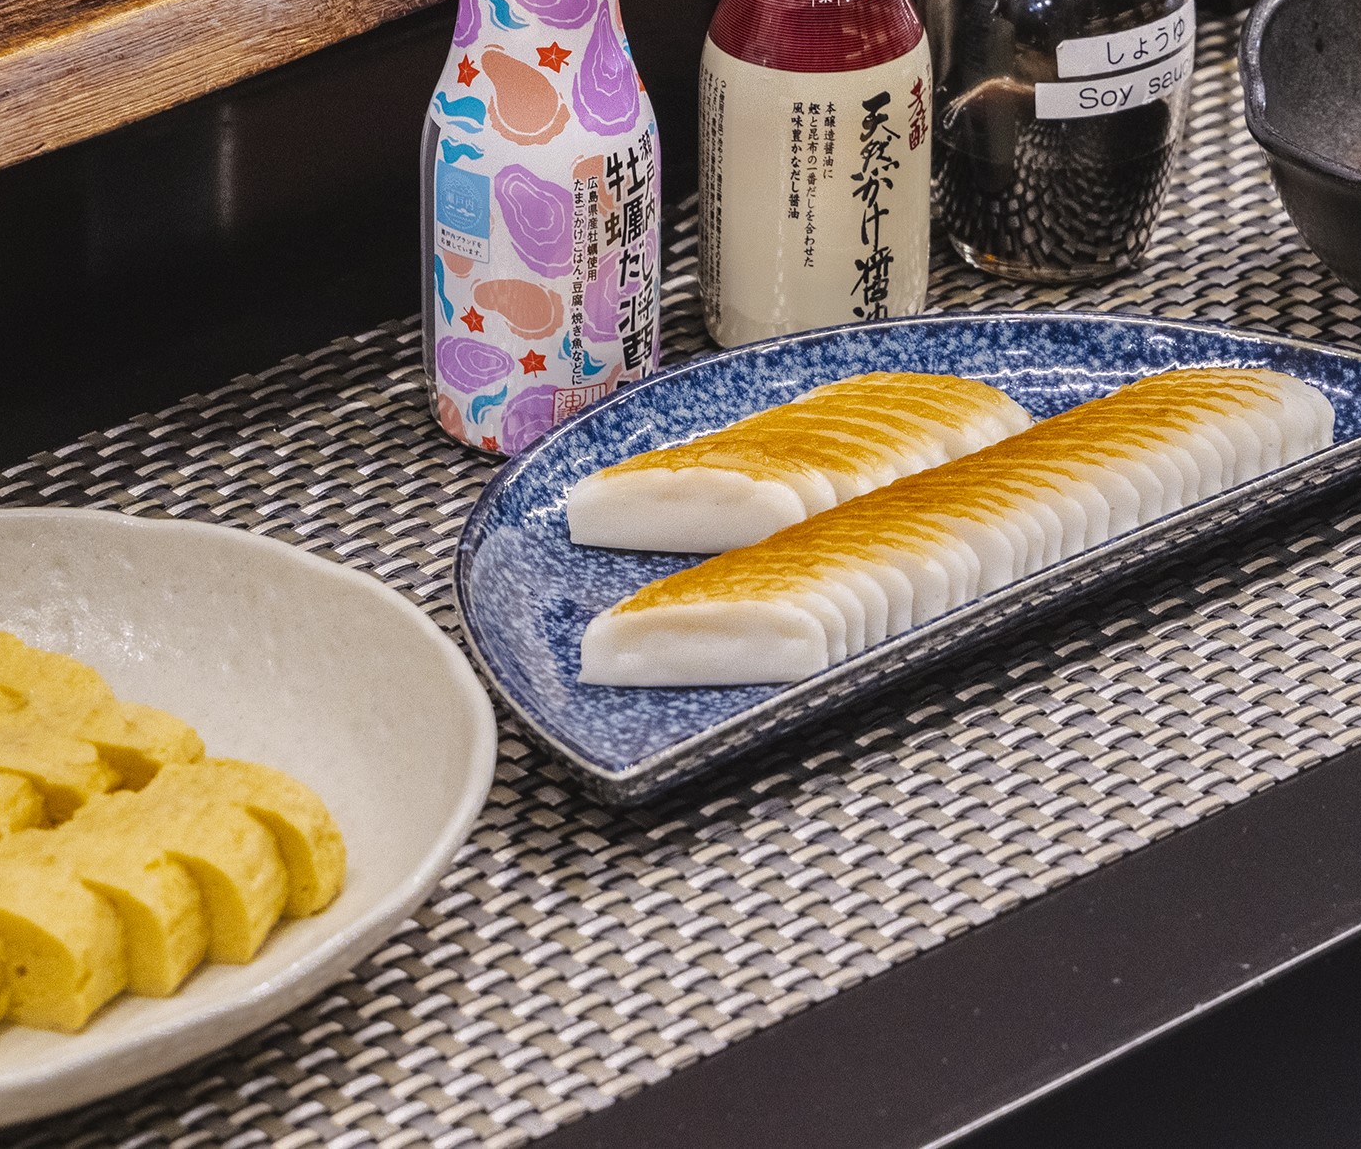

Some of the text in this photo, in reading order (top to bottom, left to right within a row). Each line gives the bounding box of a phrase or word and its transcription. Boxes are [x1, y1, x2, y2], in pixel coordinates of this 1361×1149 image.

[1107, 16, 1185, 65] しょうゆ
[822, 101, 836, 179] 本醸造醤油に
[1079, 85, 1134, 109] Soy
[638, 130, 655, 231] 瀬戸内
[788, 102, 805, 219] 風味豊かなだし醤油
[804, 102, 821, 268] 鰹と昆布の一番だしを合わせた
[587, 176, 598, 281] 広島県産牡蠣使用
[604, 147, 655, 388] 牡蠣だし醤
